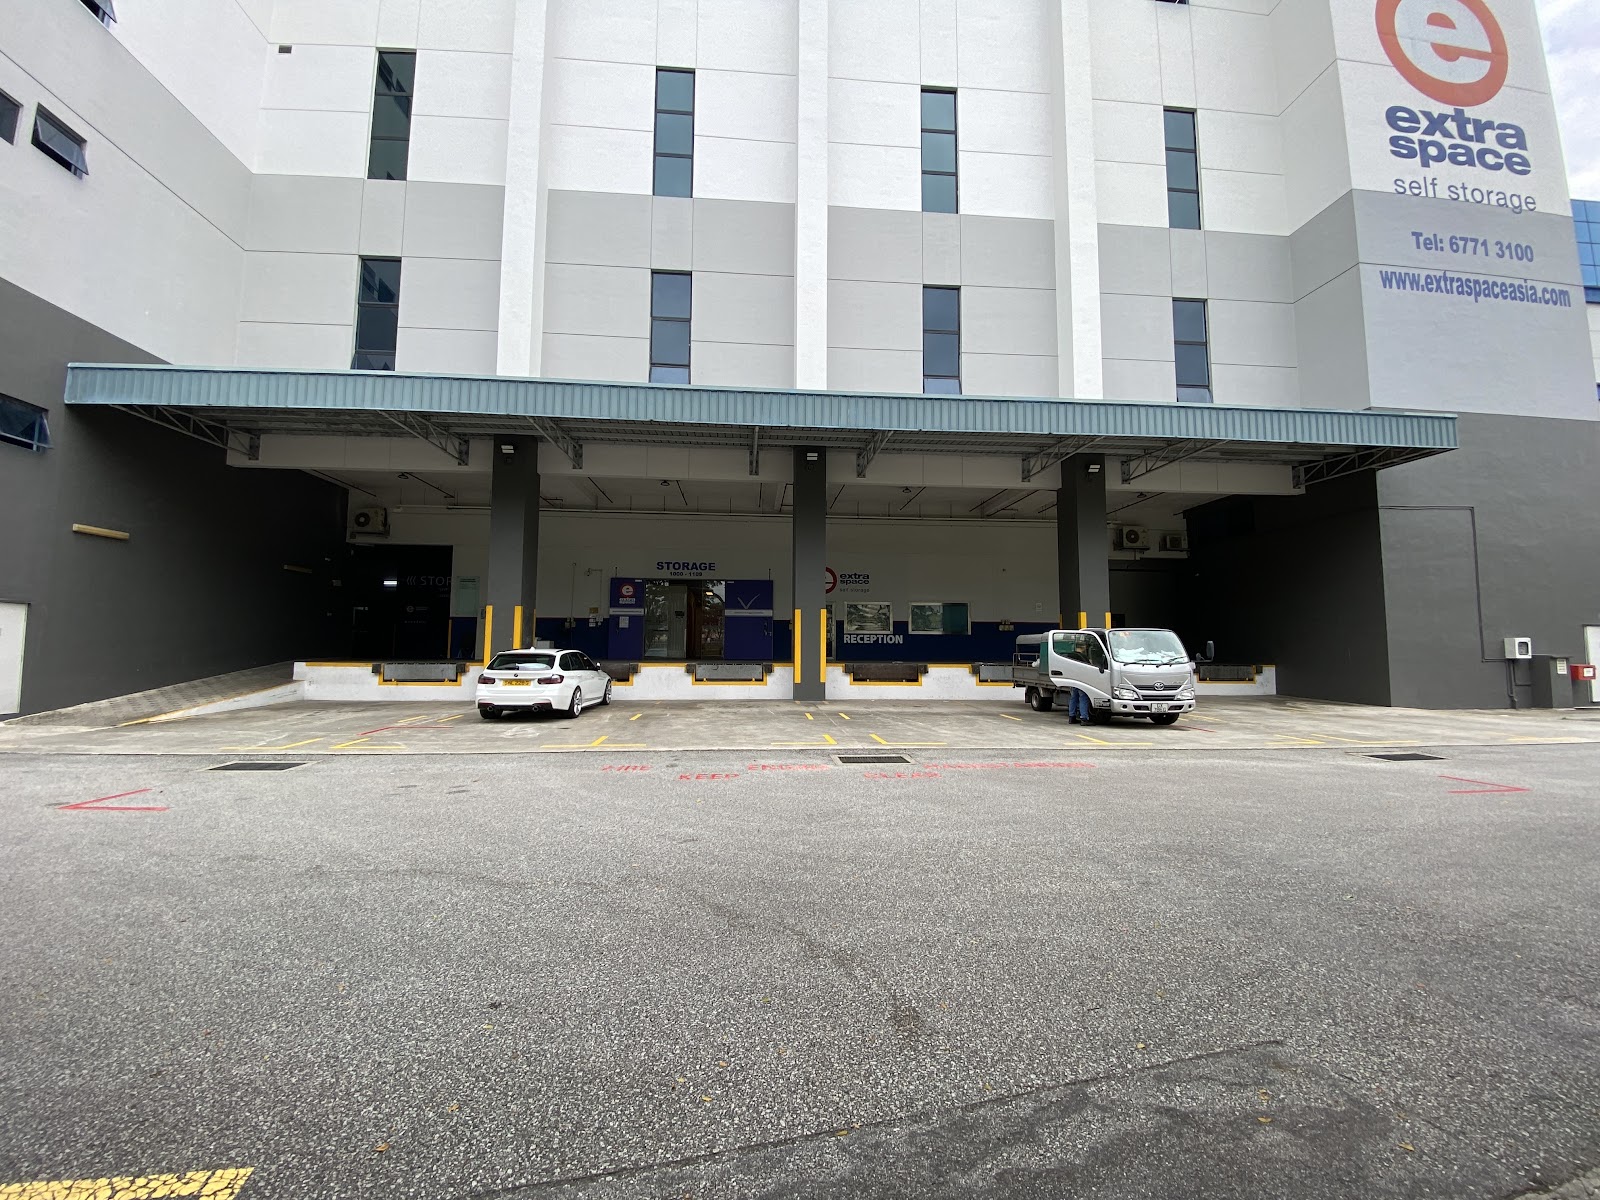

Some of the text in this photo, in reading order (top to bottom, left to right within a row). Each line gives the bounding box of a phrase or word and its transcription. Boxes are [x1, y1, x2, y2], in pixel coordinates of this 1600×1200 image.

[1385, 105, 1529, 151] extra
[1388, 135, 1532, 176] space
[1393, 176, 1537, 214] self storage
[1411, 231, 1534, 263] Tel: 6771 3100
[1379, 270, 1572, 308] www.extraspaceasia.com
[656, 561, 716, 571] STORAGE
[840, 572, 870, 580] extra
[843, 634, 904, 644] RECEPTION
